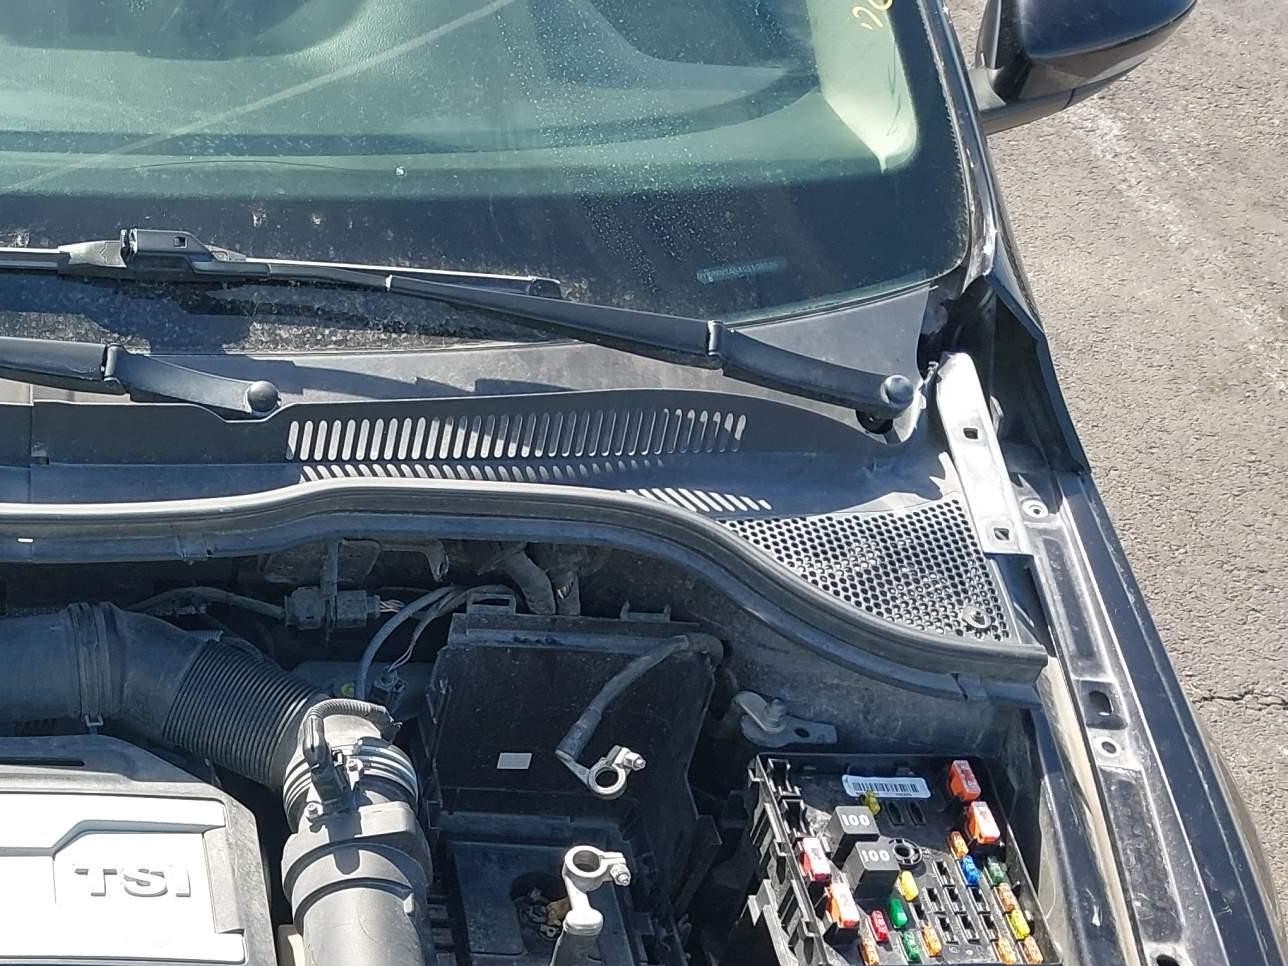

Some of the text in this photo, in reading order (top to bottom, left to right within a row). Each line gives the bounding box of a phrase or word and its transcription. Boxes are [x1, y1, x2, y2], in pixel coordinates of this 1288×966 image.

[841, 814, 871, 826] 100
[861, 849, 891, 862] 100
[72, 864, 192, 898] TSI
